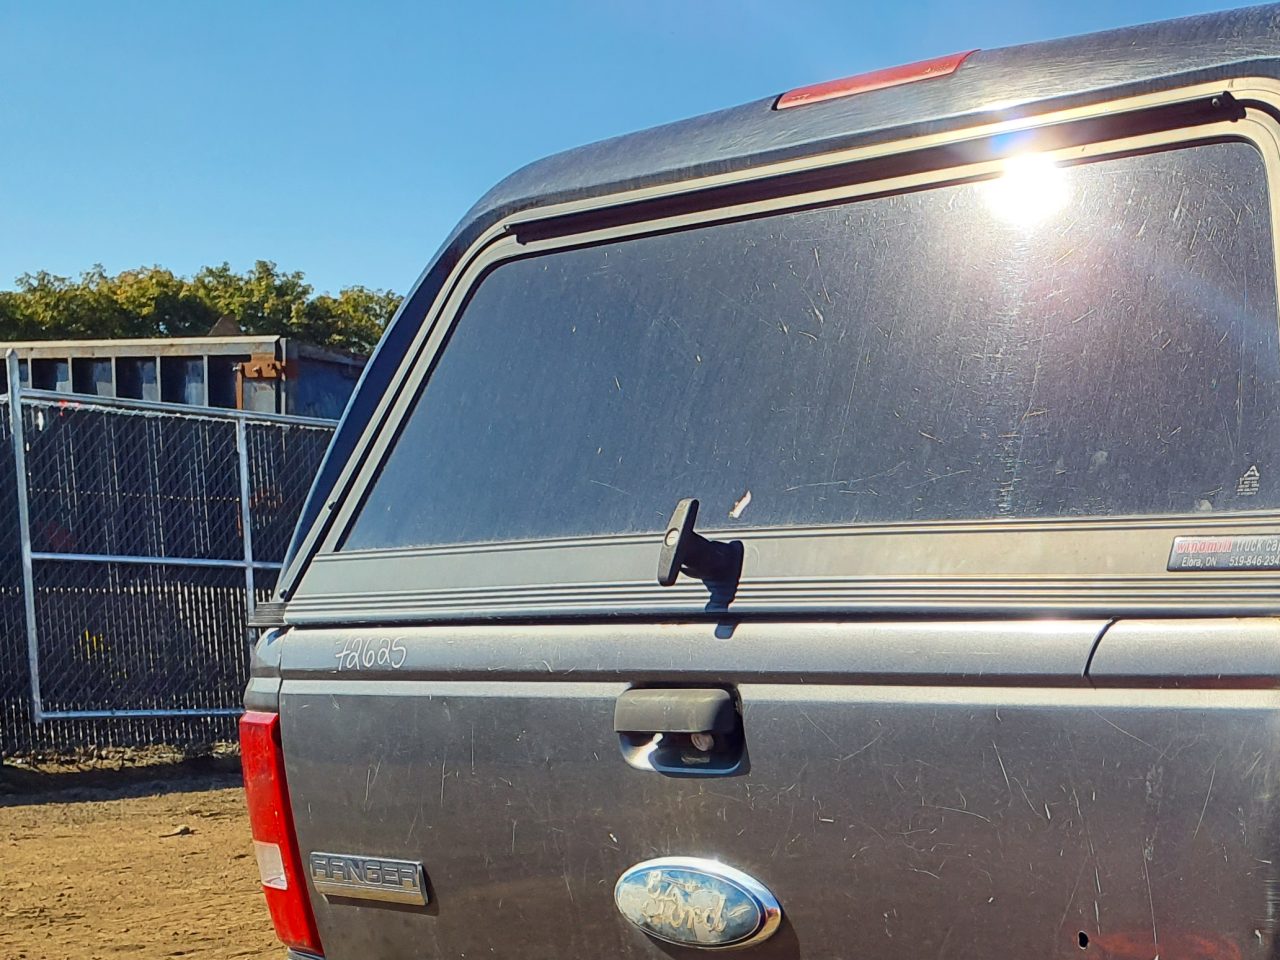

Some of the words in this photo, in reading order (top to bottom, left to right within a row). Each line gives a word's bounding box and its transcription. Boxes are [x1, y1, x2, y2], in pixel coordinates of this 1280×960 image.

[1175, 538, 1233, 554] windmill
[1235, 539, 1263, 553] truck
[1181, 556, 1203, 568] Elora,
[1205, 555, 1217, 567] ON
[311, 856, 419, 889] RANGER
